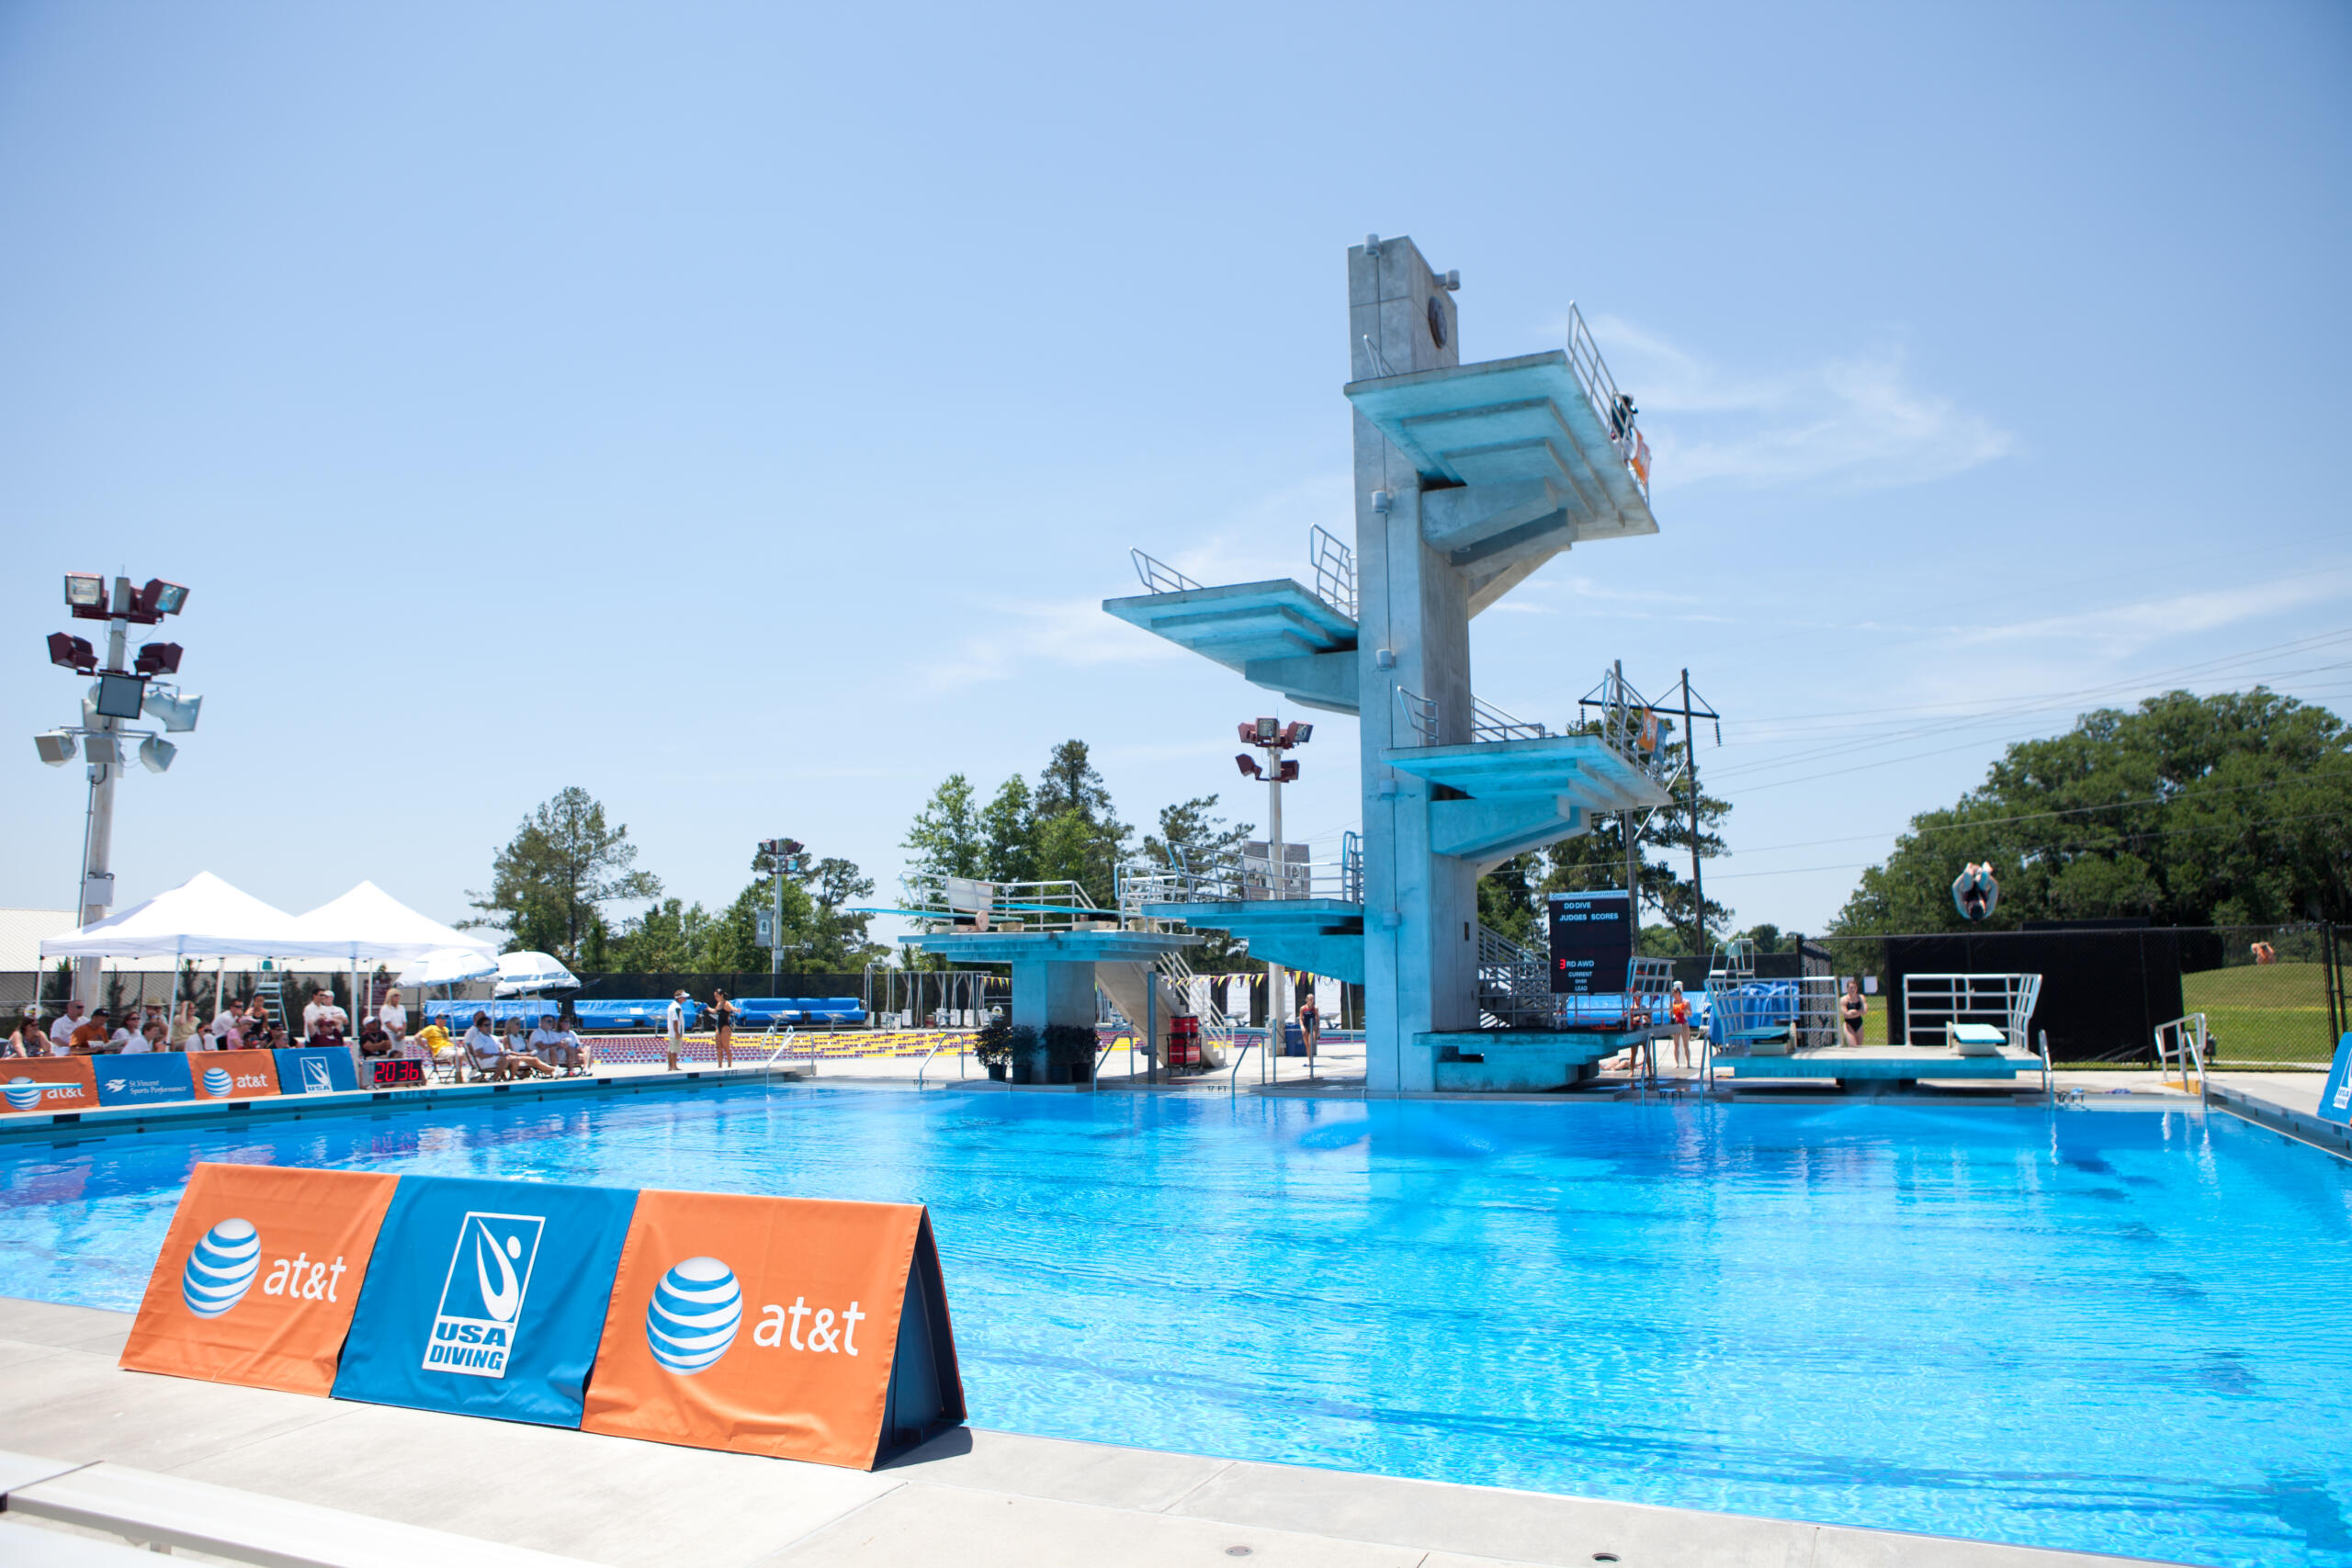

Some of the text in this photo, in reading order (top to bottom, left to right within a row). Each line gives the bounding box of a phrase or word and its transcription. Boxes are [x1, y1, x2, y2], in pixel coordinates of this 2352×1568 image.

[1575, 901, 1591, 909] DIVE
[1559, 913, 1587, 921] JUDGES
[1577, 960, 1595, 968] AWD
[236, 1073, 267, 1089] at&t
[130, 1086, 187, 1096] Sports Performance
[264, 1252, 347, 1303] at&t
[753, 1296, 865, 1357] at&t
[435, 1322, 507, 1348] USA
[428, 1344, 504, 1371] DIVING
